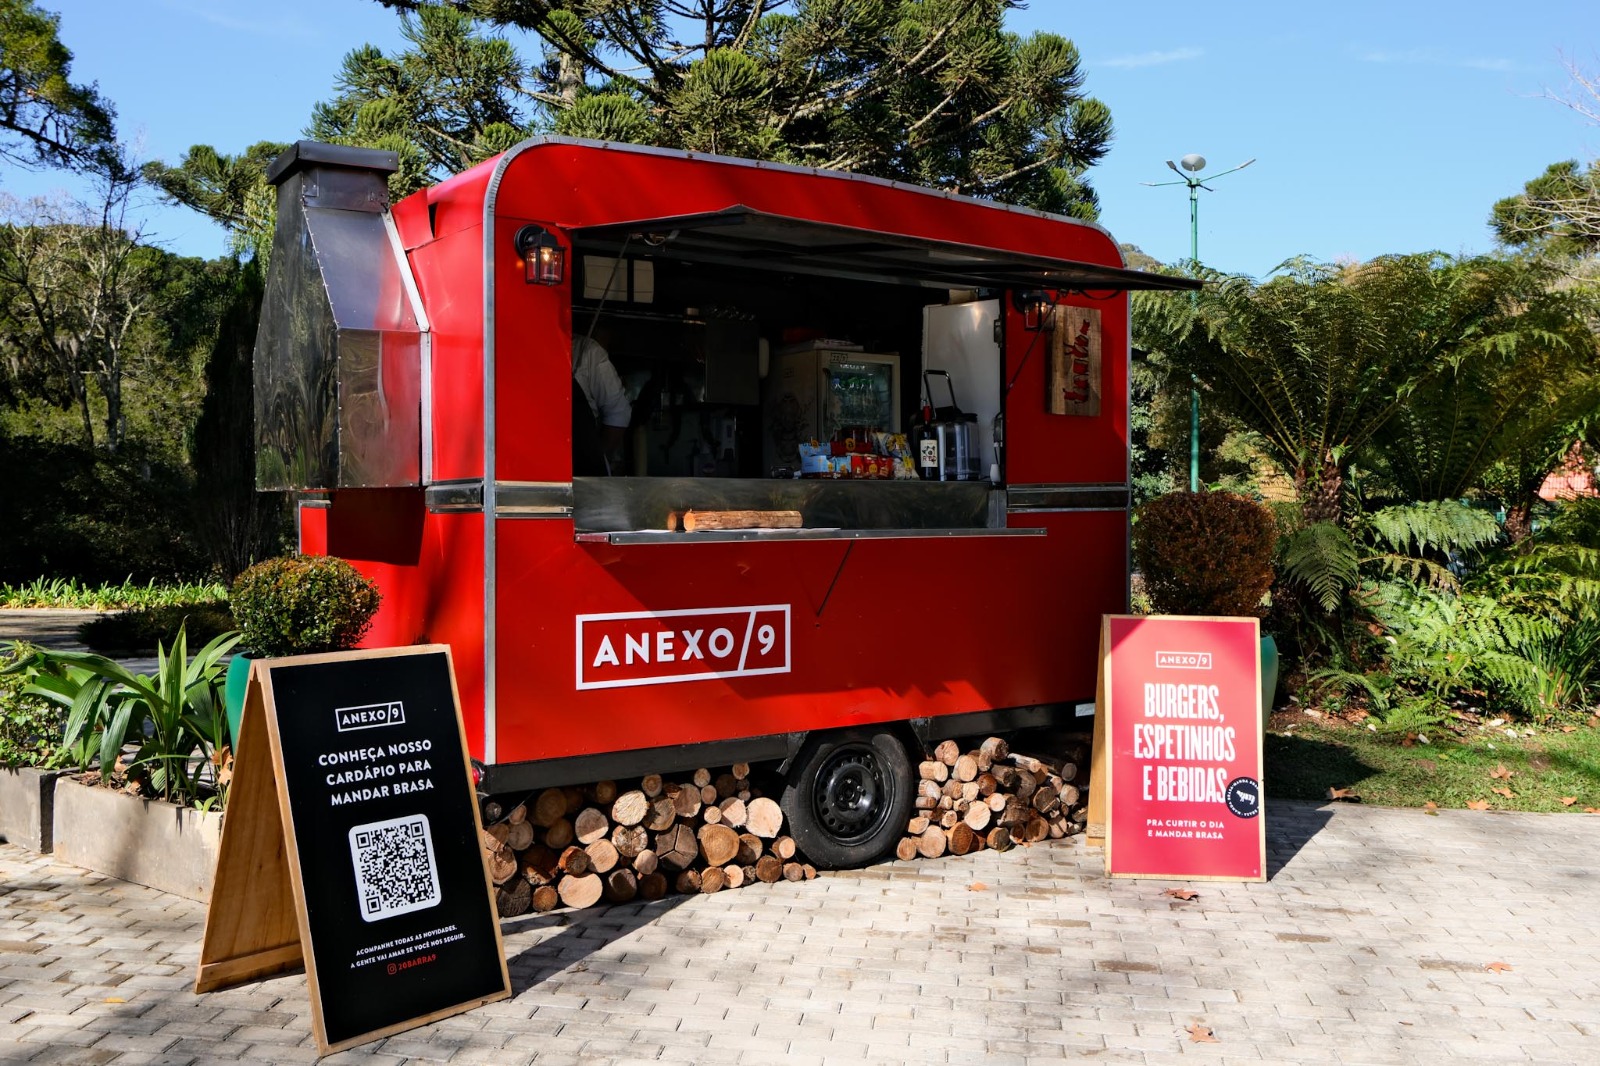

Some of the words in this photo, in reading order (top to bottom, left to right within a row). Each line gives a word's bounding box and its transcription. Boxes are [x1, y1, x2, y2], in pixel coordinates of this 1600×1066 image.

[1144, 683, 1224, 723] BURGERS,
[318, 746, 386, 766] CONHEÇA
[388, 739, 432, 756] NOSSO
[1134, 723, 1236, 762] ESPETINHOS
[326, 765, 395, 786] CARDÁPIO
[399, 759, 432, 774] PARA
[1143, 765, 1153, 800] E
[1157, 765, 1227, 803] BEBIDAS
[331, 785, 389, 806] MANDAR
[393, 778, 434, 795] BRASA
[1155, 830, 1193, 838] MANDAR
[1196, 831, 1224, 839] BRASA
[1166, 819, 1197, 828] CURTIR
[1200, 820, 1207, 828] O
[1209, 821, 1224, 829] DIA
[356, 941, 394, 956] ACOMPANHE
[395, 935, 414, 945] TODAS
[356, 956, 376, 967] GENTE
[377, 953, 387, 961] VAI
[388, 949, 405, 959] AMAR
[406, 946, 413, 954] SE
[414, 940, 430, 952] VOCÊ
[431, 938, 443, 947] NOS
